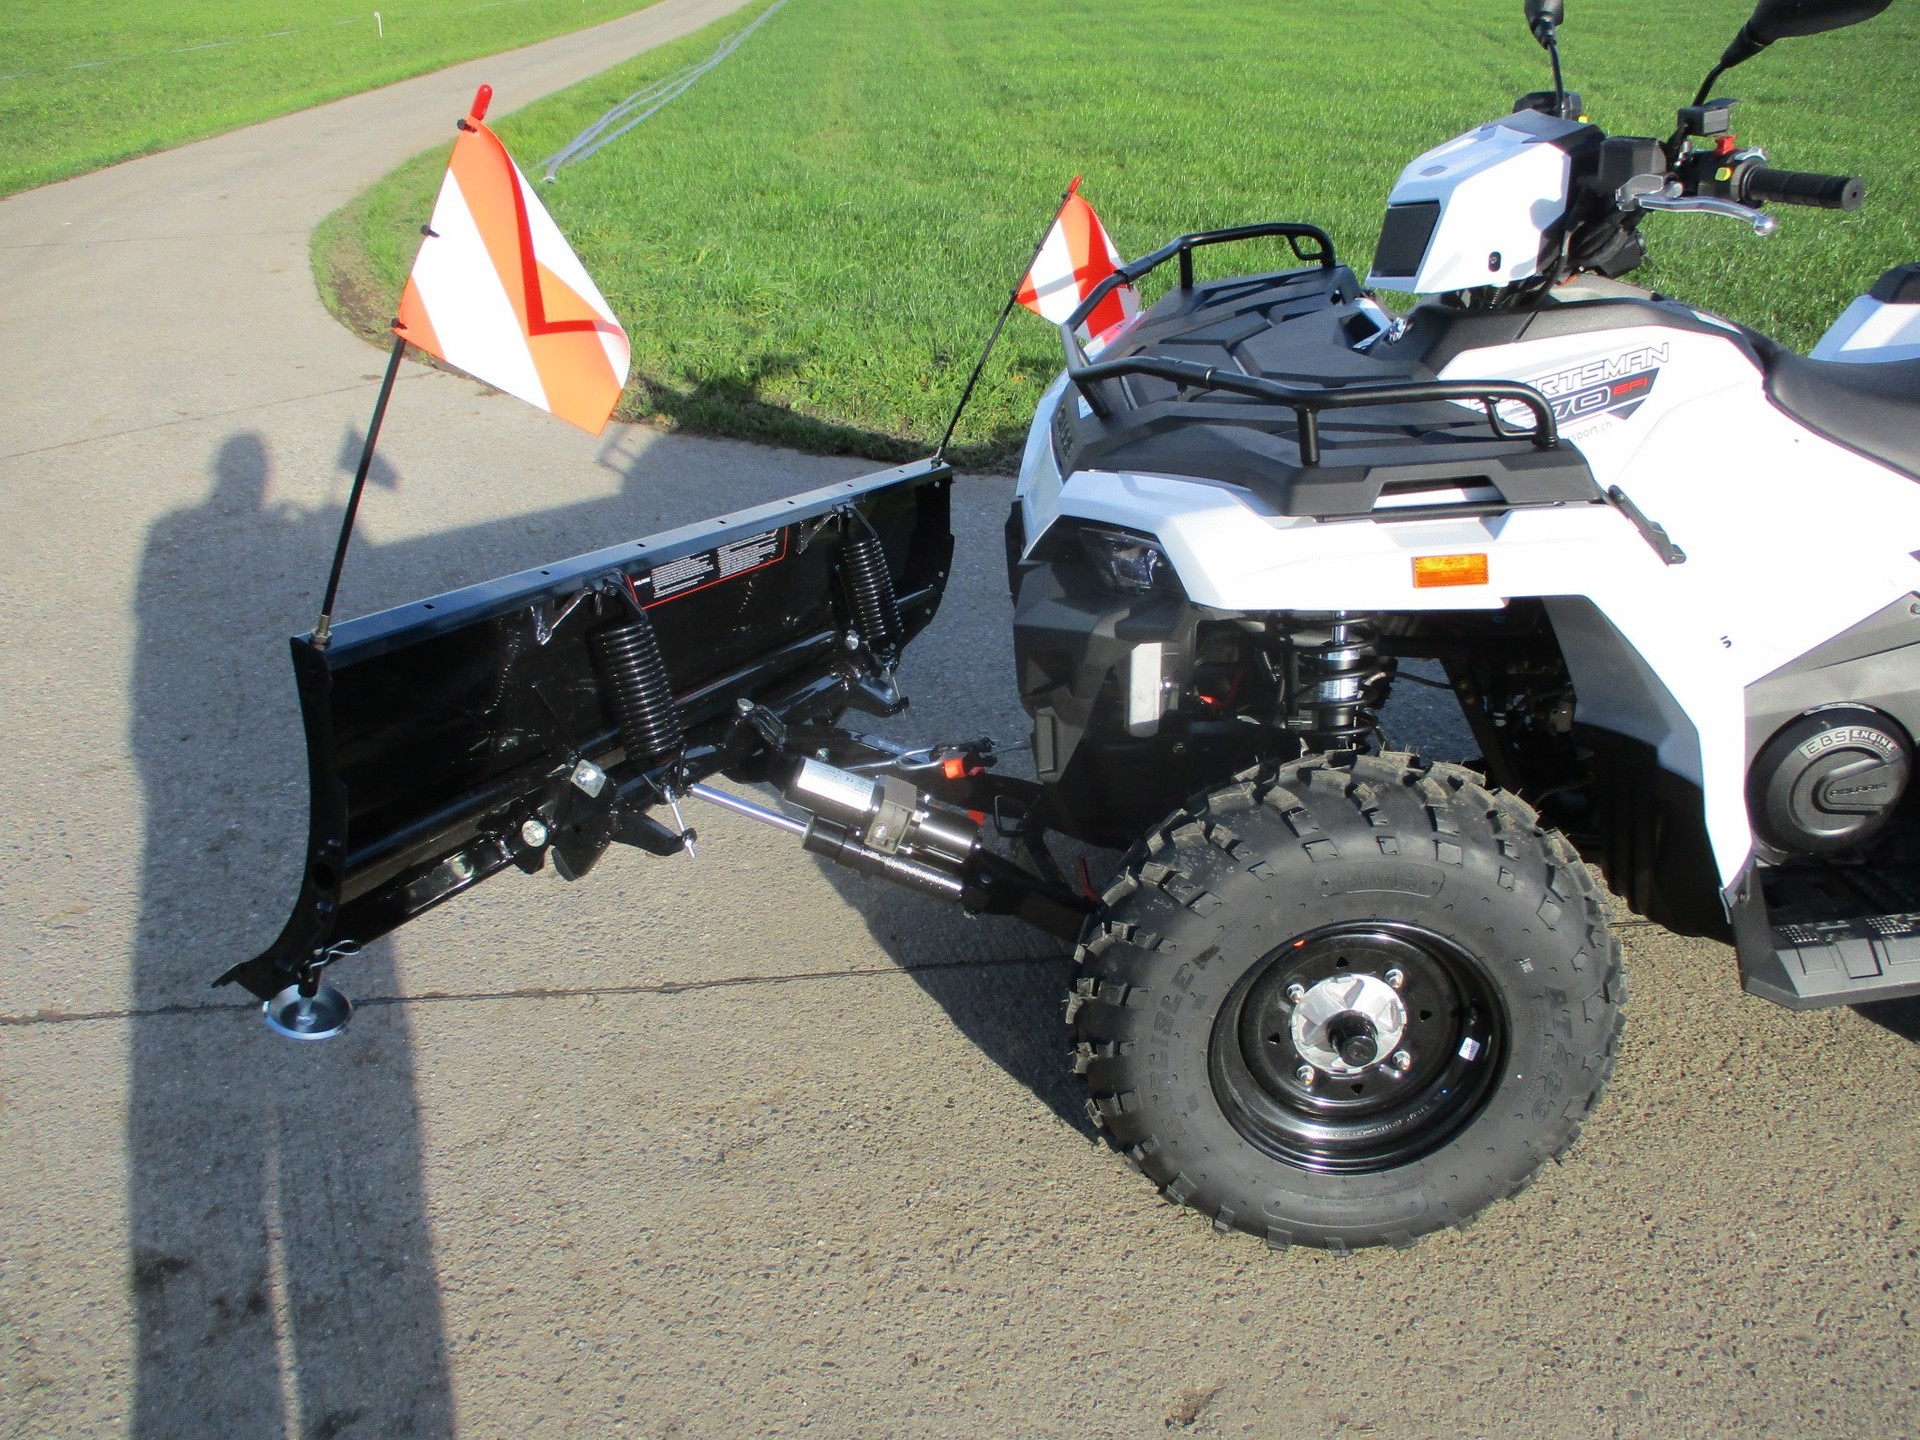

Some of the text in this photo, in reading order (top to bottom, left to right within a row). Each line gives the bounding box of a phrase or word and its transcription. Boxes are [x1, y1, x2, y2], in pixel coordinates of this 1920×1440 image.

[1500, 342, 1670, 403] RTSMAN
[1612, 377, 1649, 396] EFI
[1806, 730, 1847, 755] EBS
[1851, 730, 1895, 751] ENGINE
[1829, 782, 1888, 798] POLARIS
